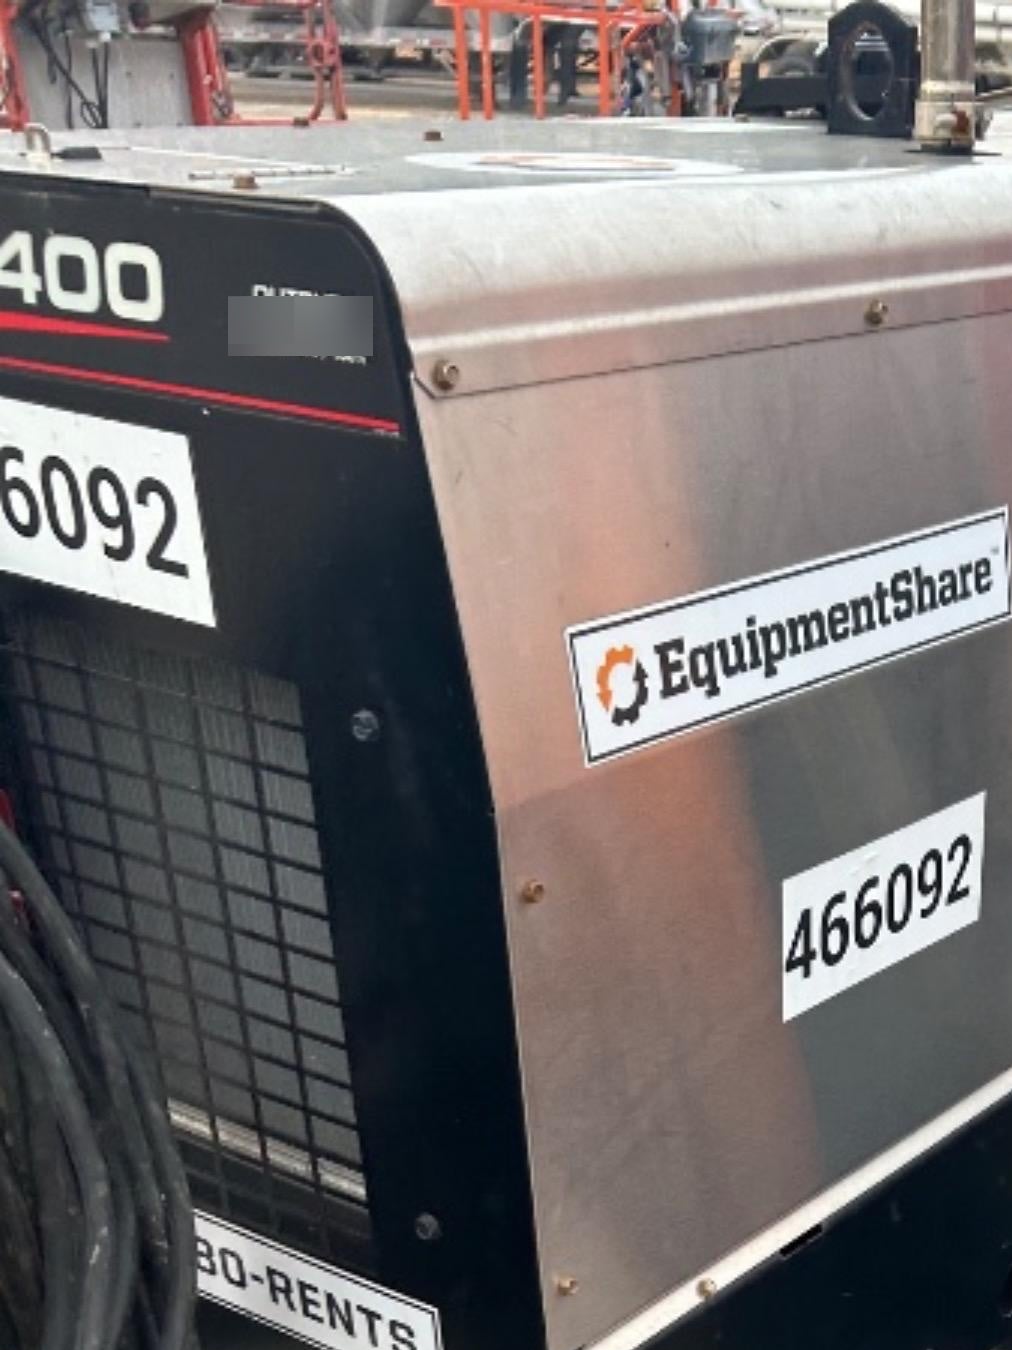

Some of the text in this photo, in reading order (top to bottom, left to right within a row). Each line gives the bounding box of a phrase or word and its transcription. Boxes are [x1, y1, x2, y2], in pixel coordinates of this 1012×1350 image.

[0, 230, 165, 322] 400
[0, 446, 190, 579] 6092
[653, 556, 994, 699] EquipmentShare
[784, 833, 973, 979] 466092
